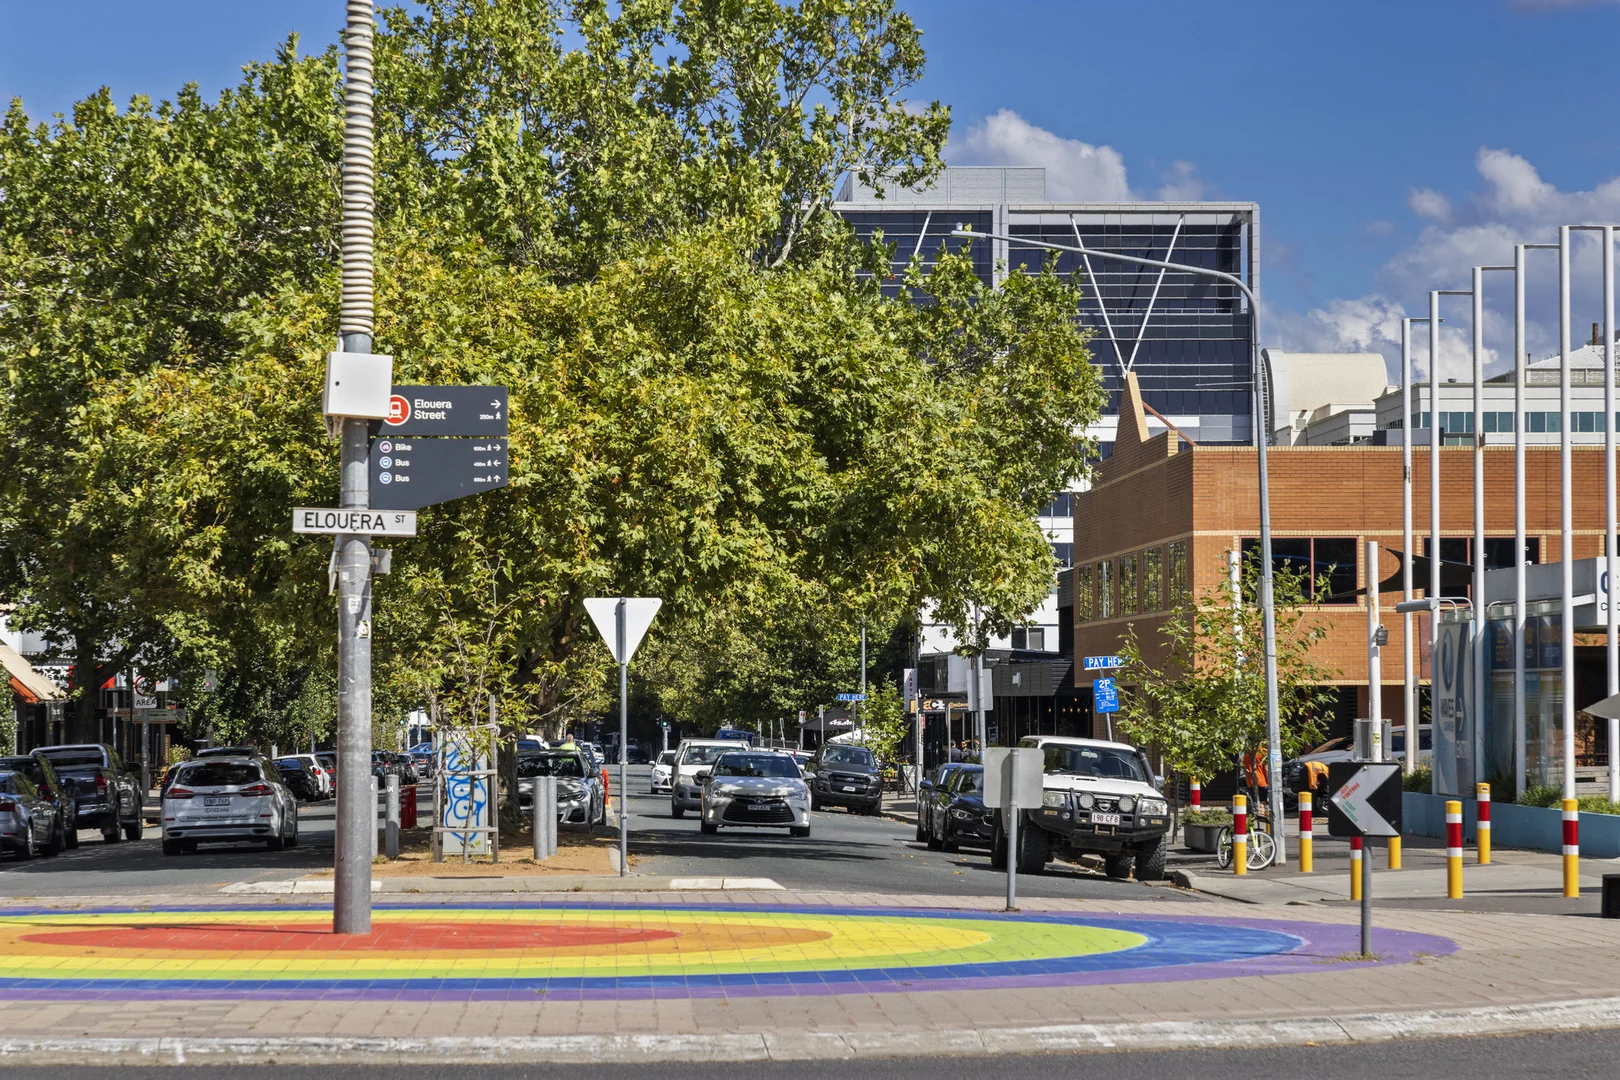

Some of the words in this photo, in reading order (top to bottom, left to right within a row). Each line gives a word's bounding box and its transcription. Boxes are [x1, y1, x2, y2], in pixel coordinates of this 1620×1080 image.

[414, 398, 453, 409] Elouera
[414, 410, 446, 420] Street
[395, 443, 412, 451] Bike
[395, 459, 410, 467] Bus
[395, 474, 410, 482] Bus
[304, 512, 386, 531] ELOUERA
[394, 514, 406, 523] ST
[1088, 657, 1104, 668] PAY
[1108, 656, 1126, 667] HER
[1098, 679, 1111, 689] 2P
